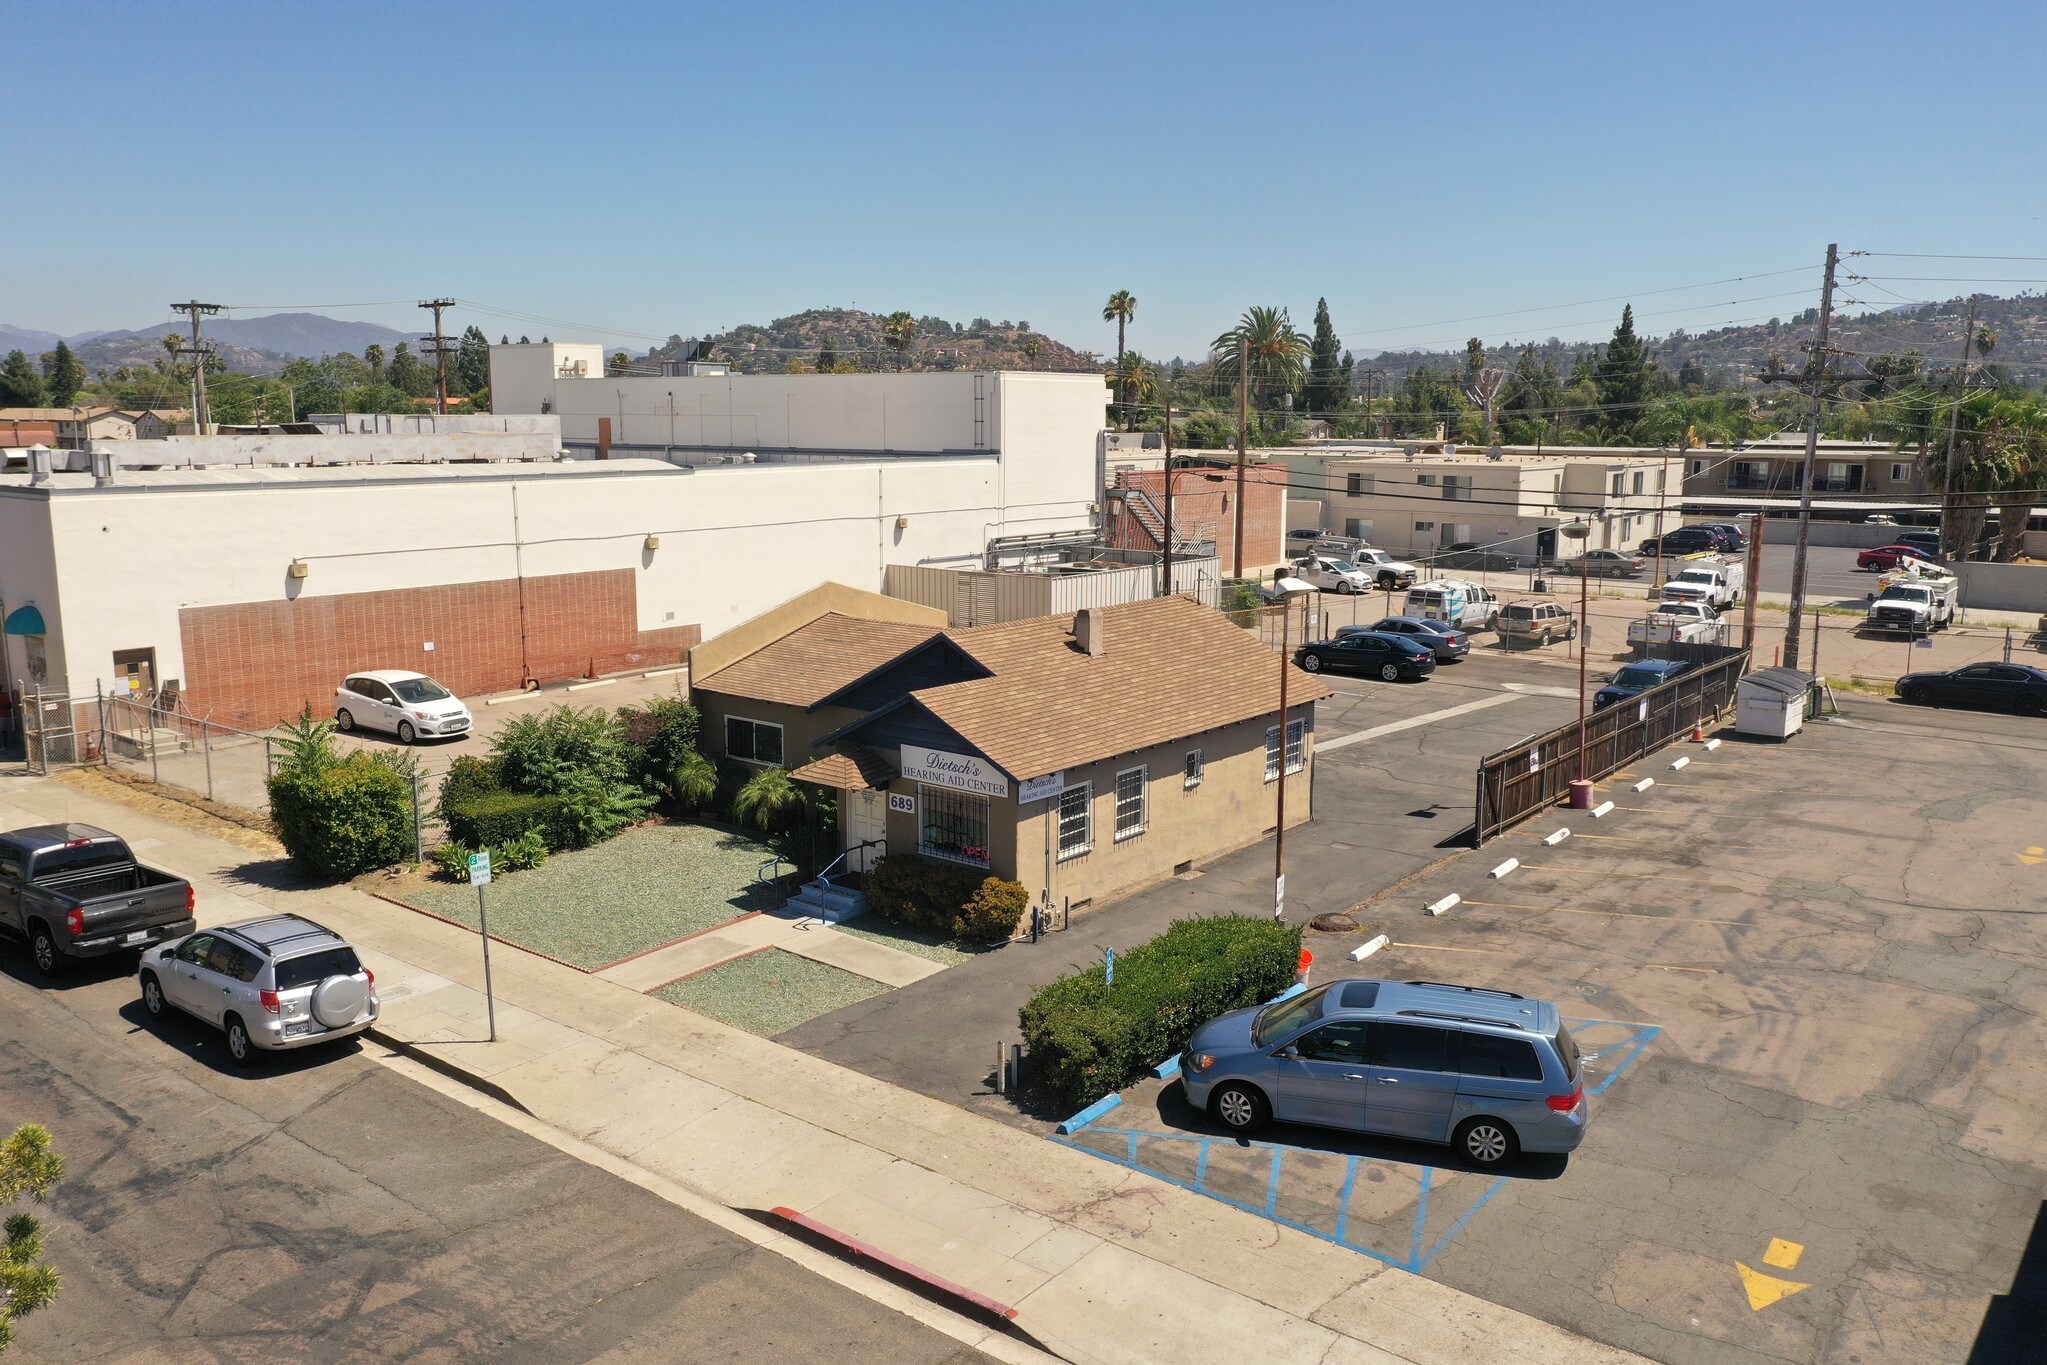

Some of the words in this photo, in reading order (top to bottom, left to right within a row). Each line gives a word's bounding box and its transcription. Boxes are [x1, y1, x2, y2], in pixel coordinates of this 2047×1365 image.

[926, 752, 981, 777] Dietsch's
[904, 766, 945, 783] HEARING
[948, 775, 965, 787] AID
[967, 779, 1006, 795] CENTER
[1048, 785, 1063, 794] CENTER
[891, 795, 913, 811] 689
[470, 856, 477, 864] 2
[962, 845, 989, 860] OPEN
[472, 864, 488, 872] PARKING
